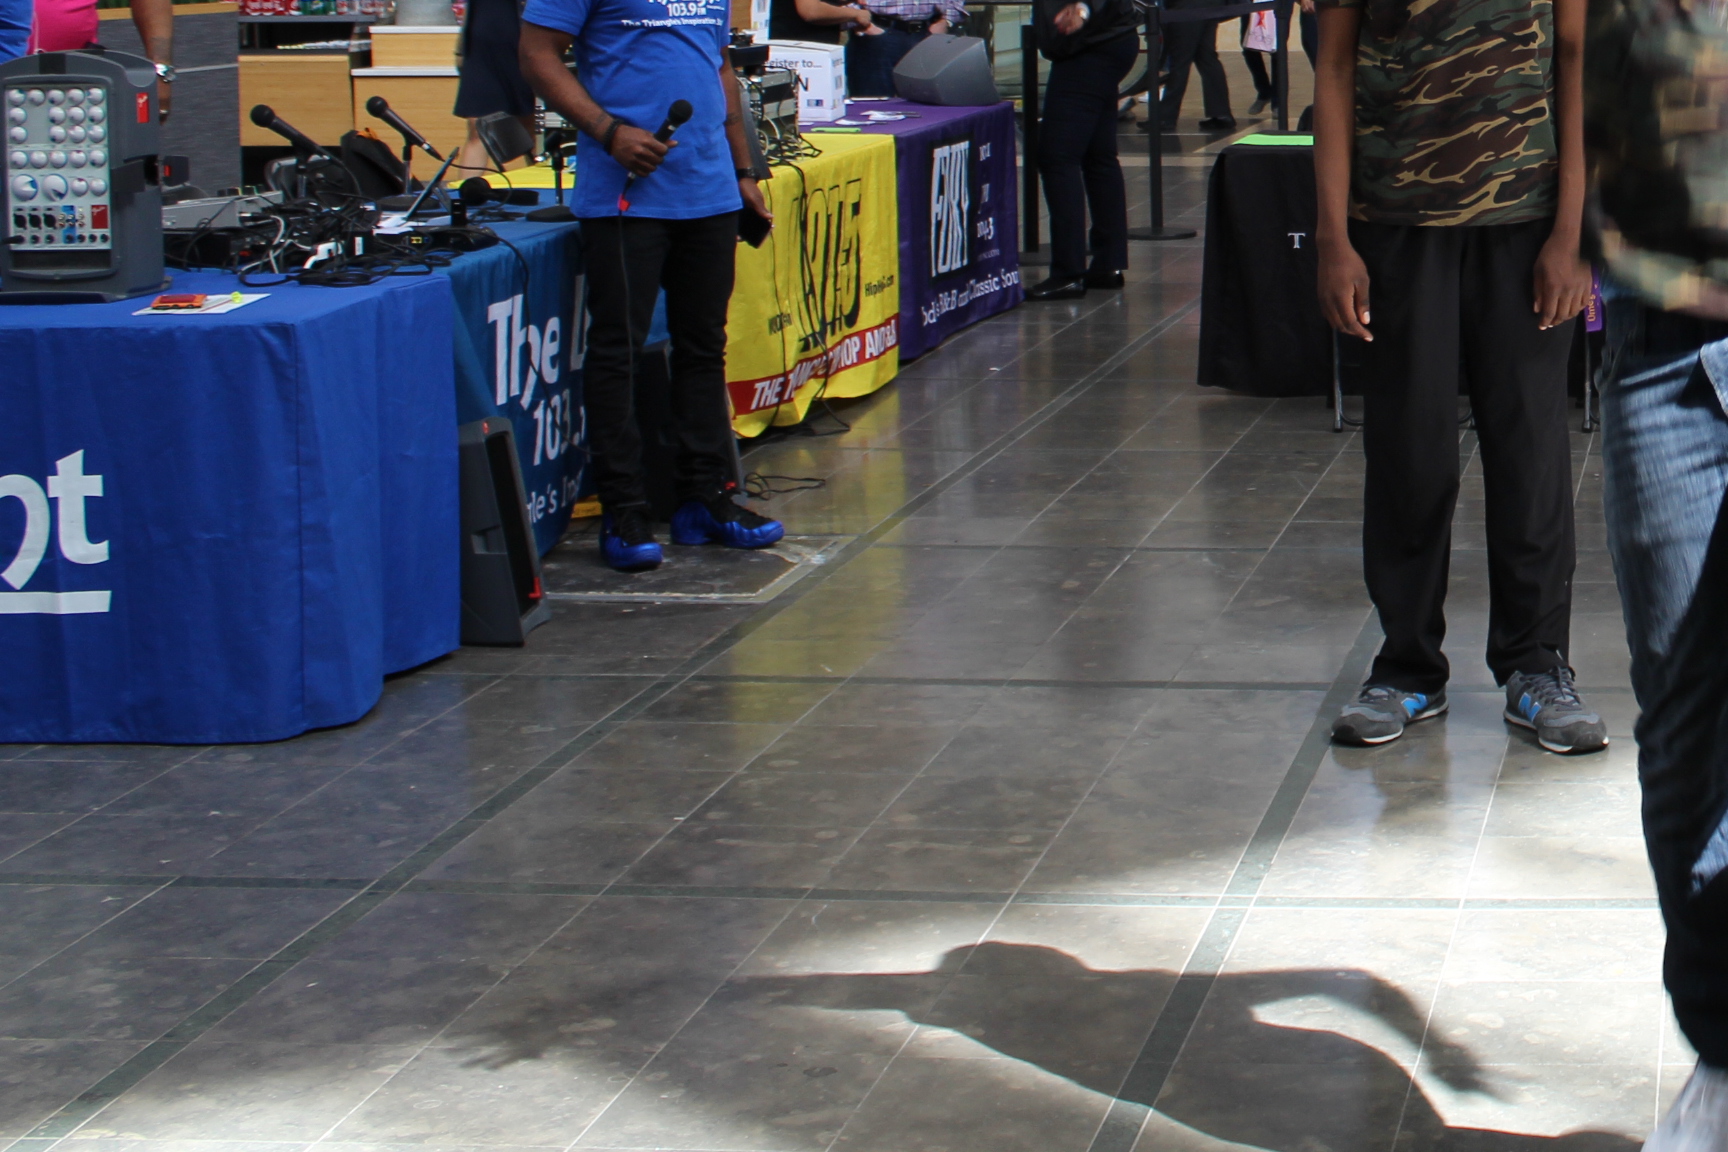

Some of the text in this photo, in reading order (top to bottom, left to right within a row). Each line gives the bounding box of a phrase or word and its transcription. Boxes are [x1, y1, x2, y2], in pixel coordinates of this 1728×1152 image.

[667, 2, 697, 17] 103.9
[765, 59, 799, 70] egister
[487, 293, 560, 411] The
[750, 376, 786, 410] THE
